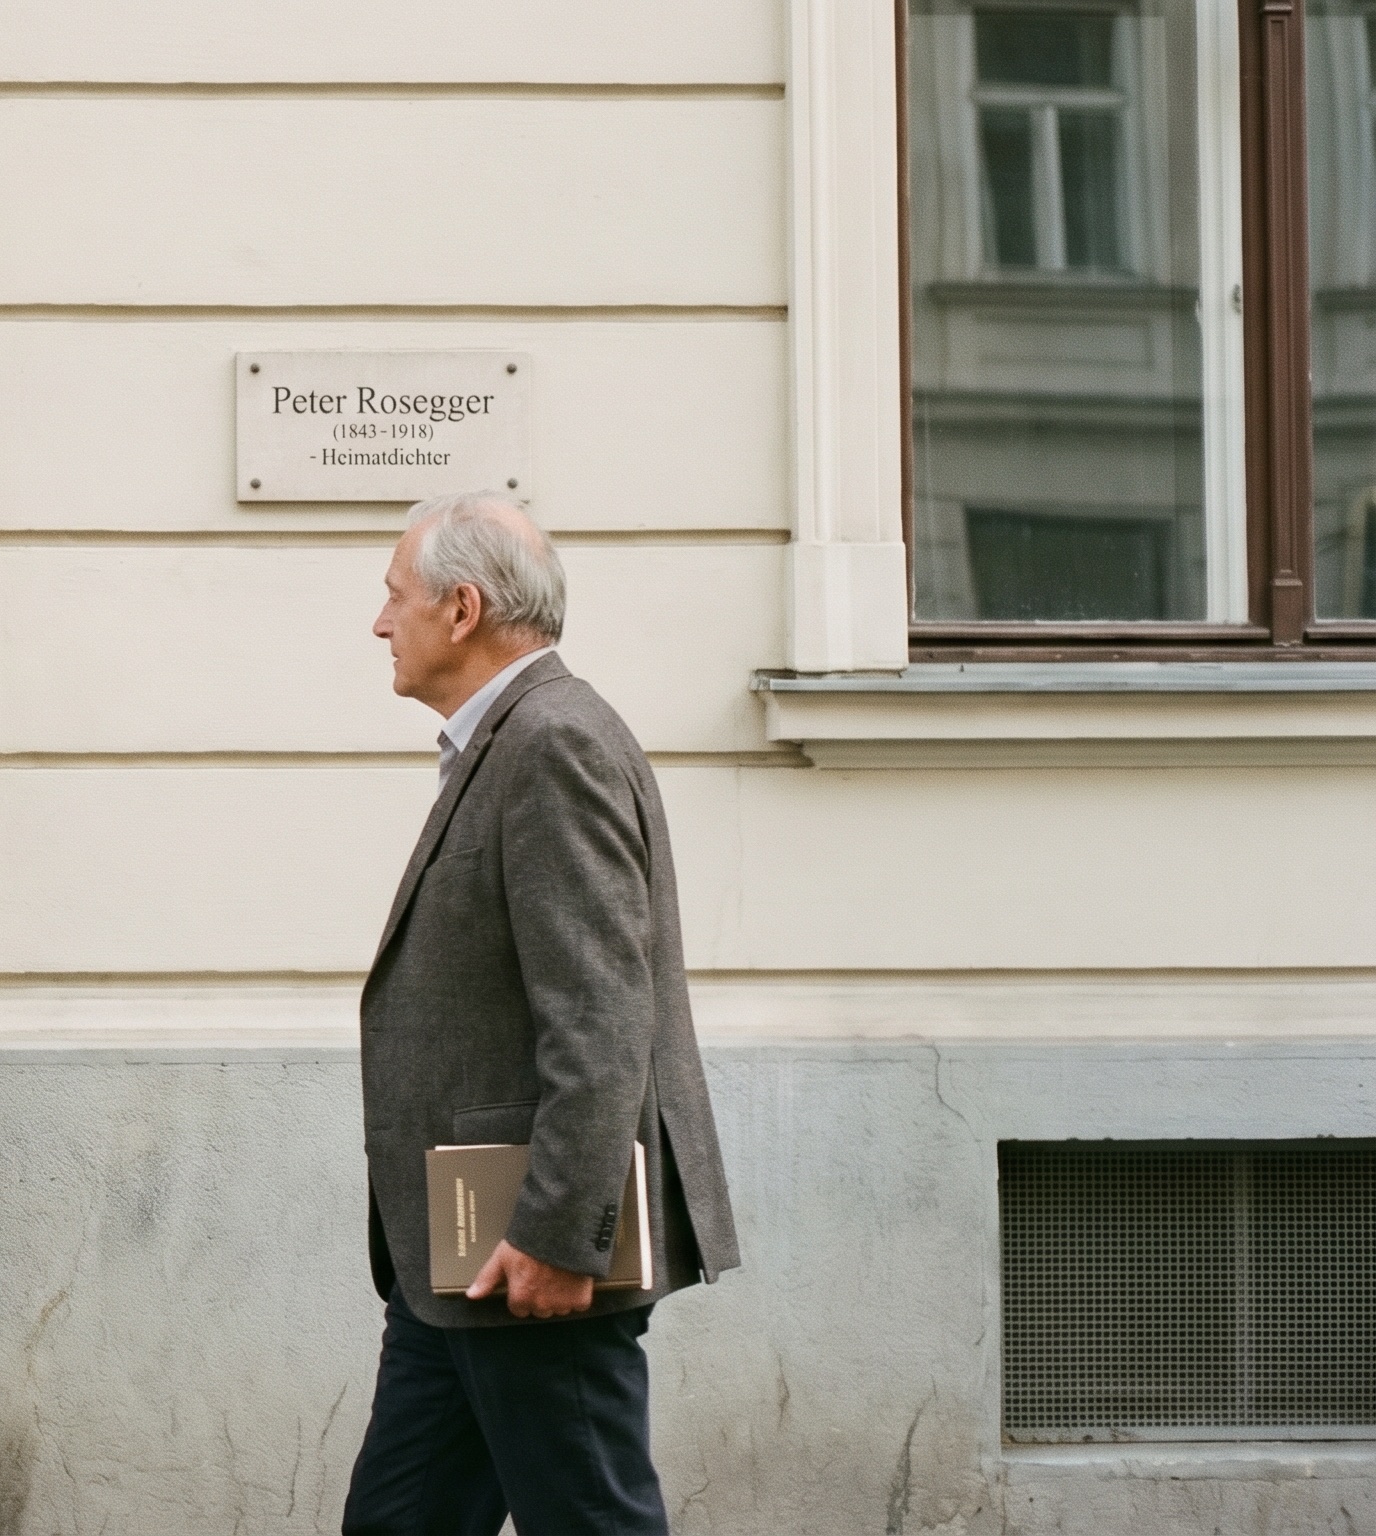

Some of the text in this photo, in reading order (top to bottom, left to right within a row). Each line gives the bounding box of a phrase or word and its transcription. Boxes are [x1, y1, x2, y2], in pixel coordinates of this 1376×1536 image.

[272, 386, 495, 422] Peter Rosegger
[322, 448, 451, 466] Heimatdichter
